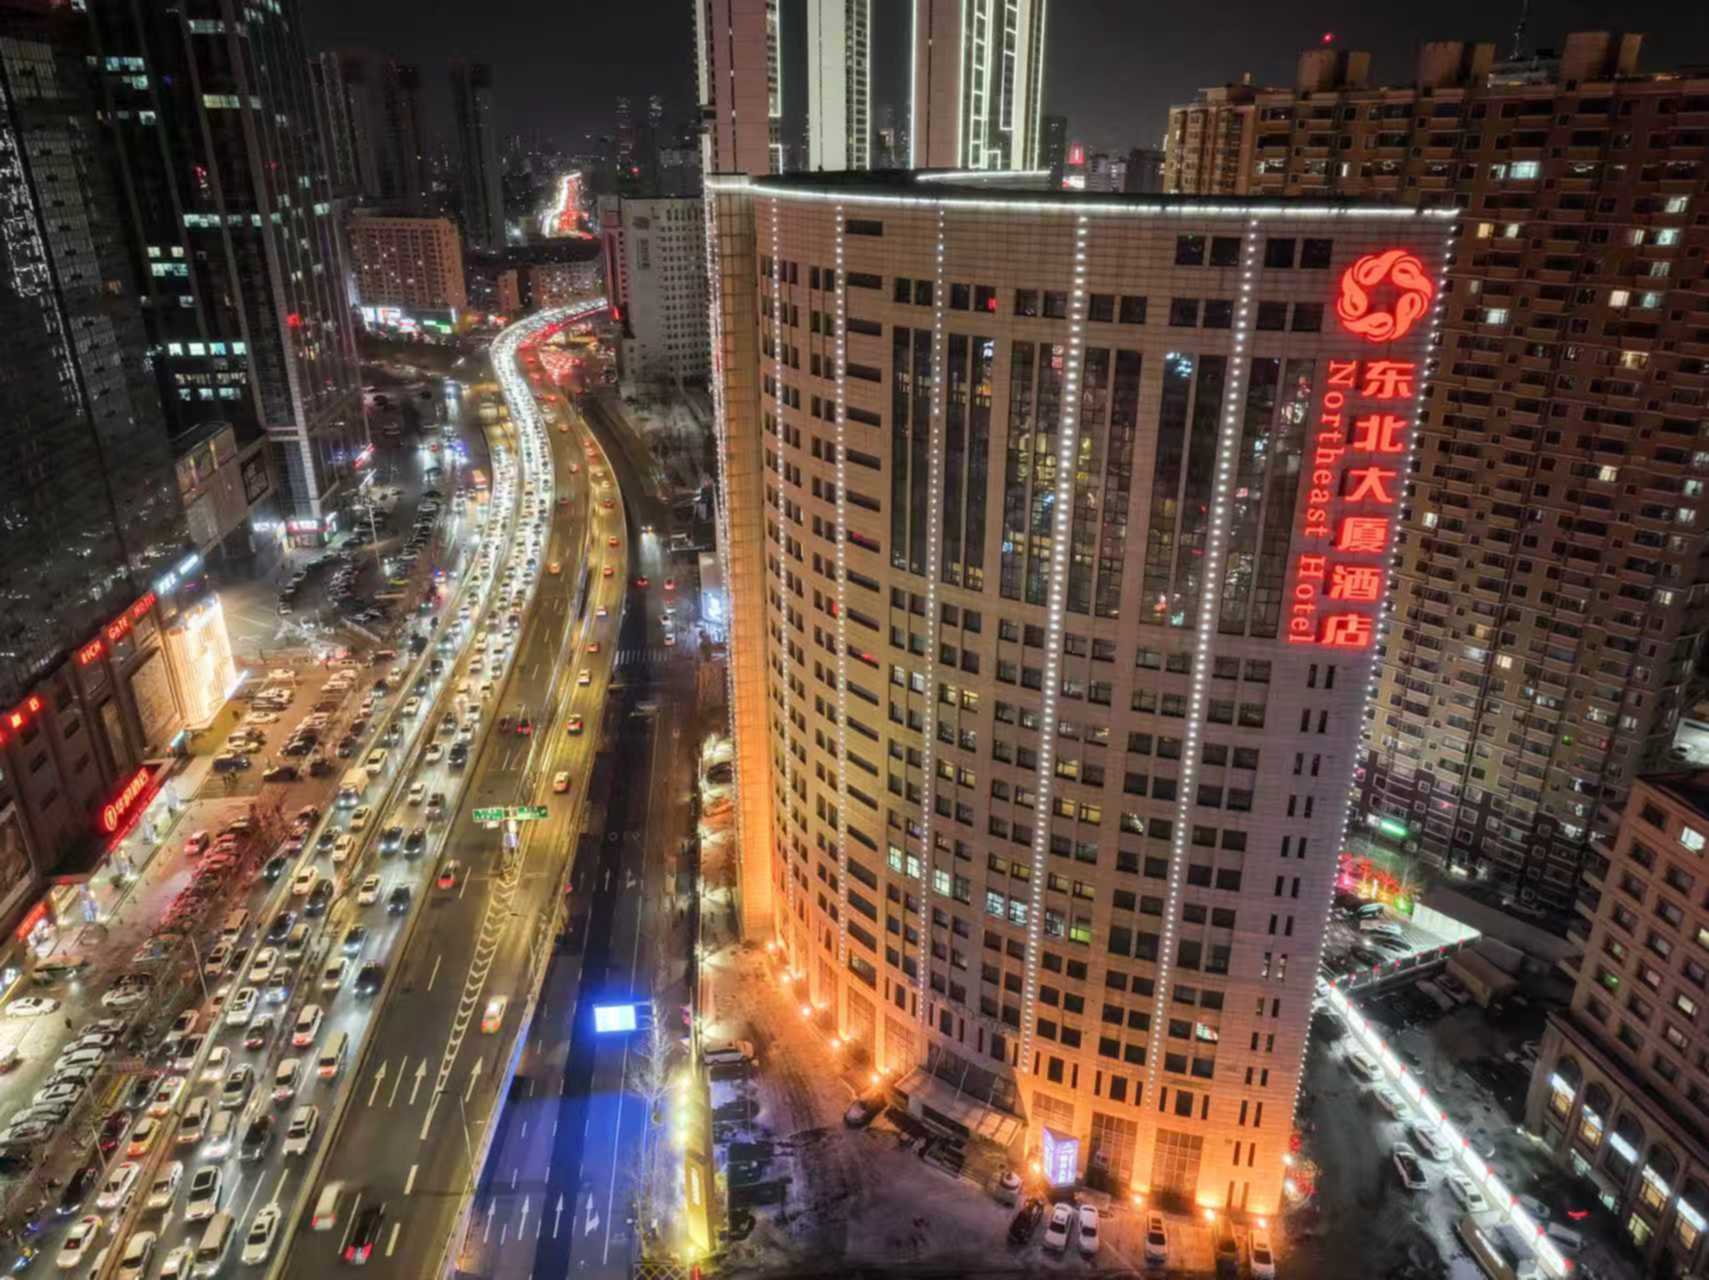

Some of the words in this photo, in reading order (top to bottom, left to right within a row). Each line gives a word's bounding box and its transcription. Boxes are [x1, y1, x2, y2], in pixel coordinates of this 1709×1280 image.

[1305, 360, 1357, 538] Northeast
[1321, 360, 1415, 648] 东北大厦酒店
[1288, 555, 1327, 643] Hotel
